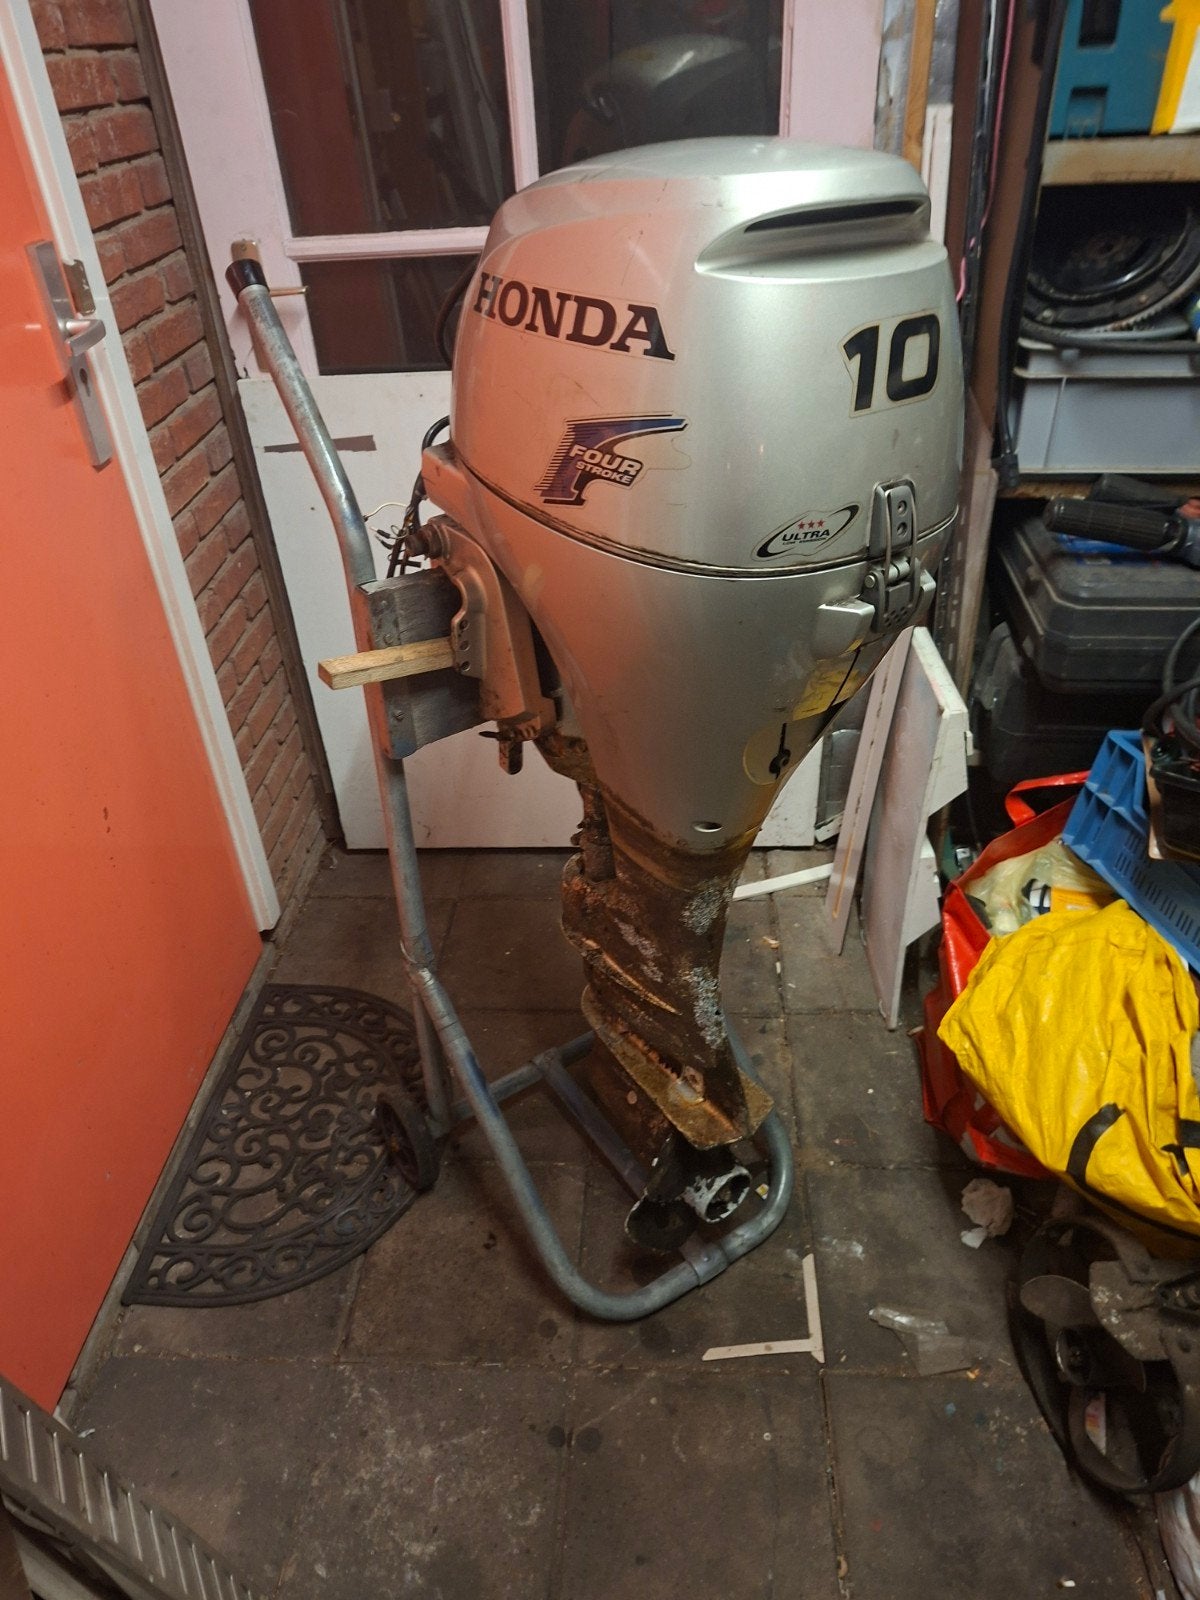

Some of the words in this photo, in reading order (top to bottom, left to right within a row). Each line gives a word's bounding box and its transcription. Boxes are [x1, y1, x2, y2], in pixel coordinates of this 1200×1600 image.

[473, 271, 676, 361] HONDA
[843, 313, 941, 412] 10
[569, 444, 642, 476] FOUR
[575, 461, 634, 484] STROKE
[782, 529, 830, 541] ULTRA
